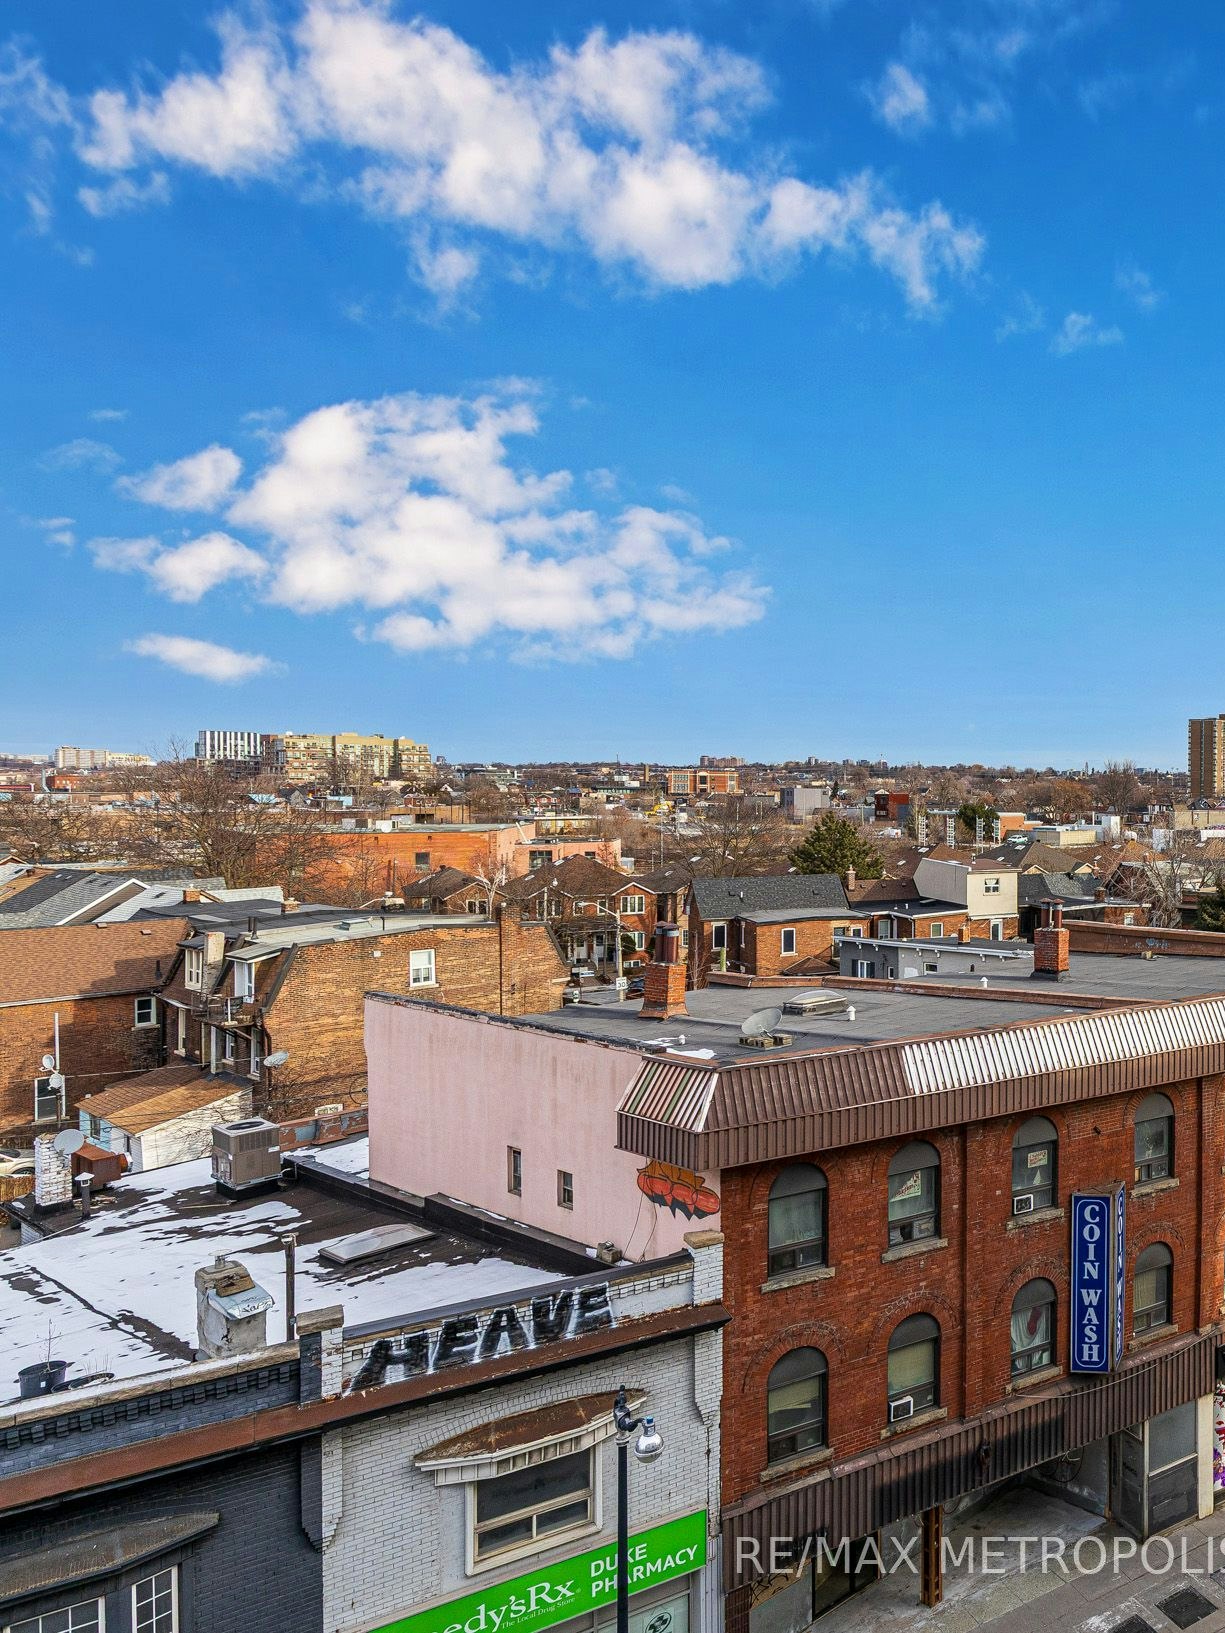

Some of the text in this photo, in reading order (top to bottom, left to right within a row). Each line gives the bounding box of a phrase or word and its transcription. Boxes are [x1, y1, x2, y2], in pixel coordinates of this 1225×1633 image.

[1080, 1204, 1102, 1362] COIN WASH
[590, 1543, 648, 1578] DUKE
[501, 1597, 576, 1629] The Local Drug Store
